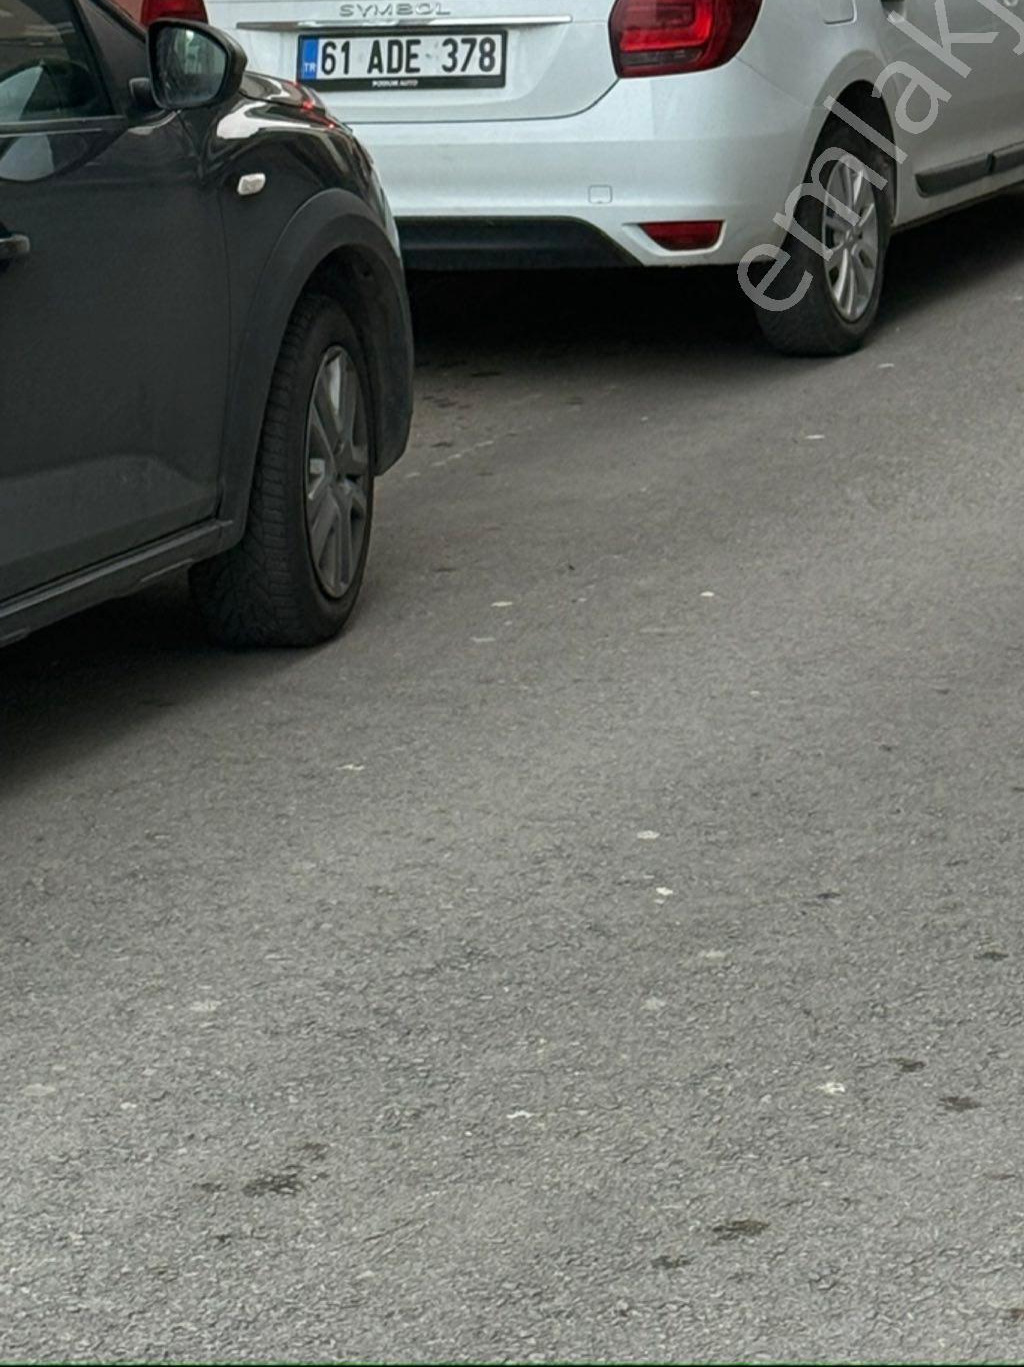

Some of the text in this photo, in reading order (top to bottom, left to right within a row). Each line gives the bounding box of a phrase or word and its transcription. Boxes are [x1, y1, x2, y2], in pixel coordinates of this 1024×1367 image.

[339, 3, 451, 17] SYMBOL
[321, 36, 496, 75] 61 ADE 378
